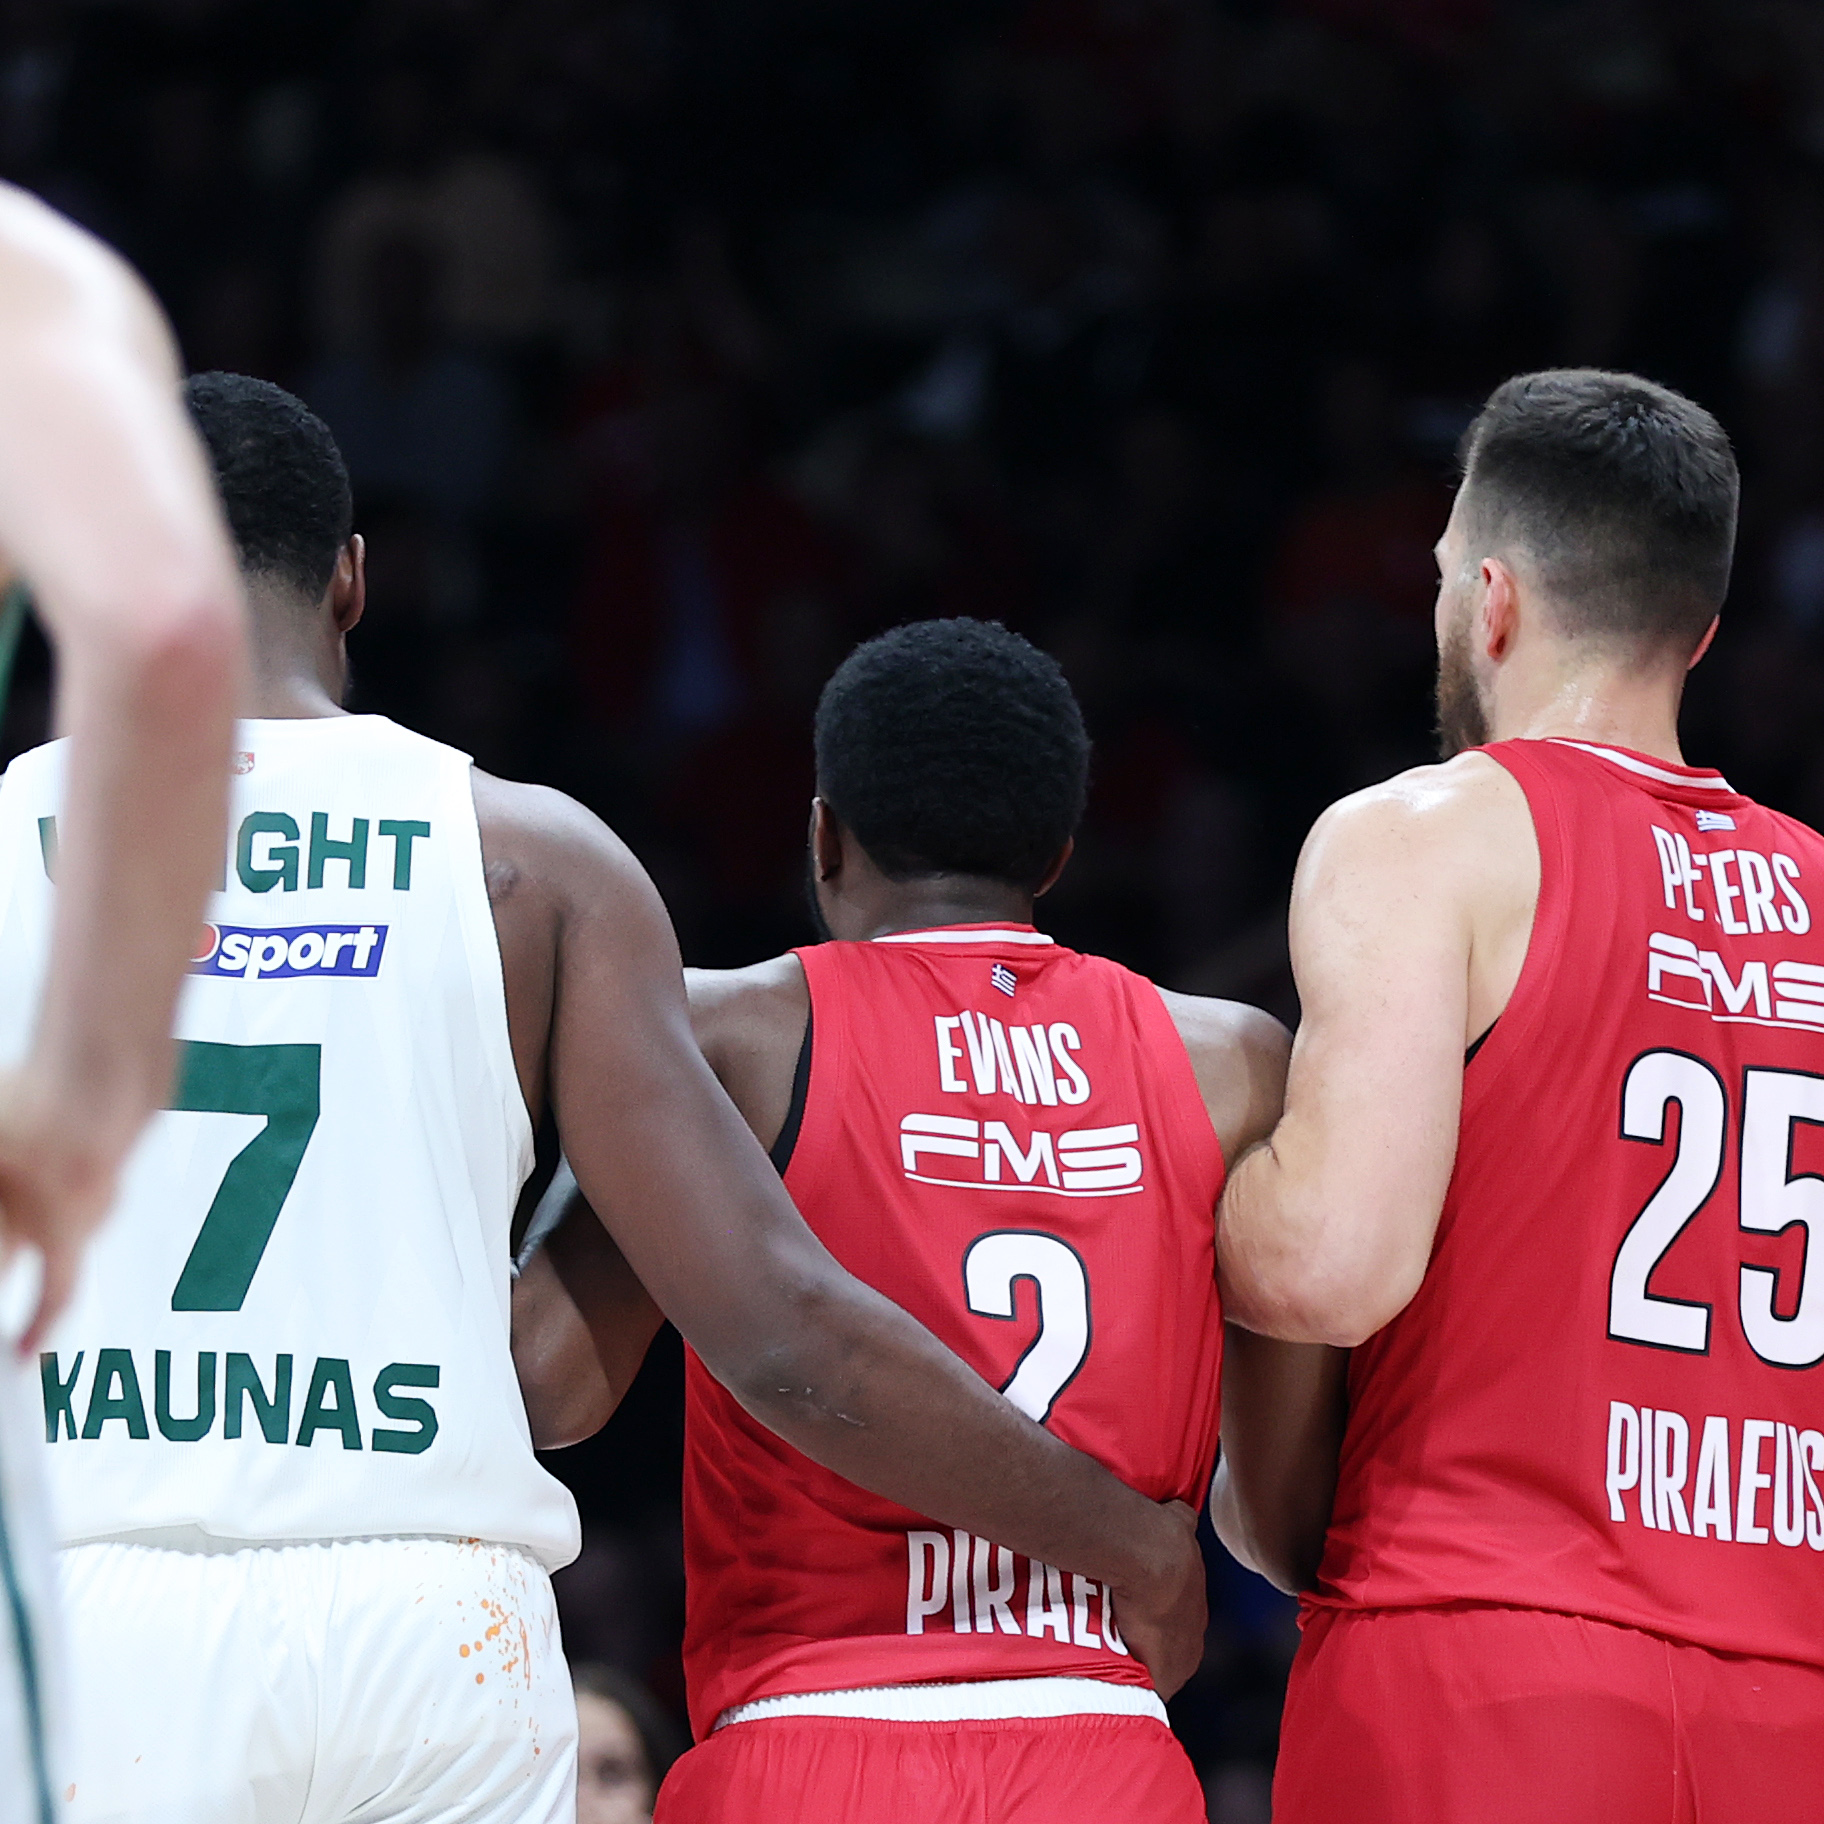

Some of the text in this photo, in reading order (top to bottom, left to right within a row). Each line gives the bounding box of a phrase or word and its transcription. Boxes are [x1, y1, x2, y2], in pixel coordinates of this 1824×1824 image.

[1651, 824, 1812, 935] PEERS
[934, 1009, 1092, 1107] EVANS
[899, 1112, 1144, 1191] FMS
[961, 1228, 1093, 1425] 2
[39, 1348, 441, 1455] KAUNAS
